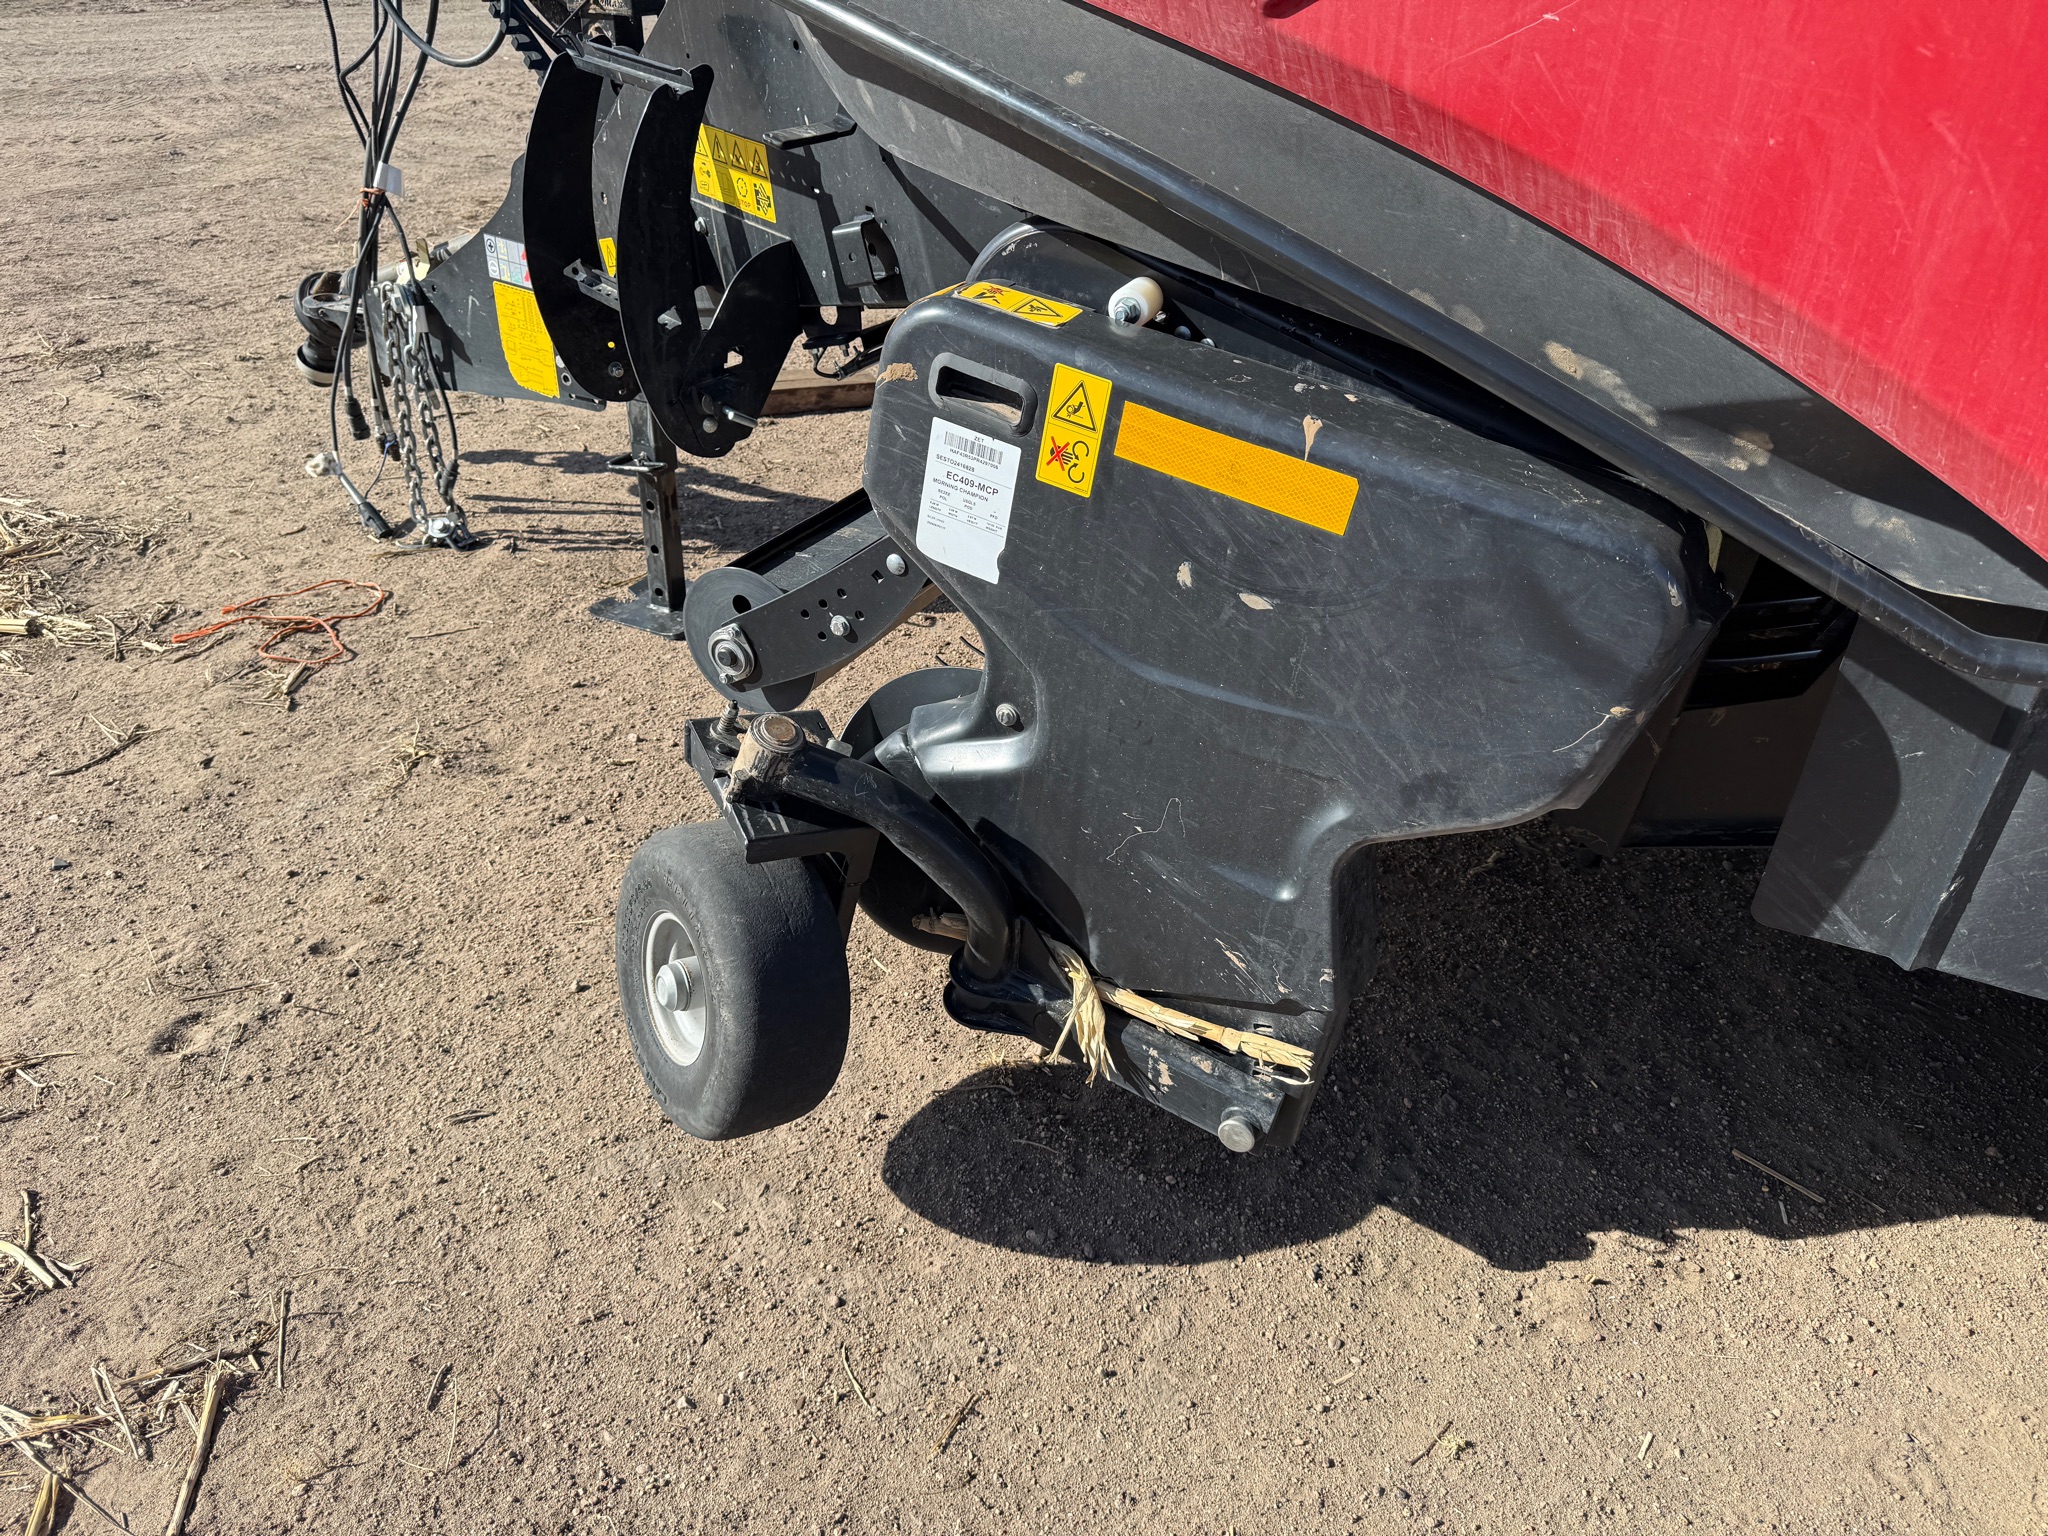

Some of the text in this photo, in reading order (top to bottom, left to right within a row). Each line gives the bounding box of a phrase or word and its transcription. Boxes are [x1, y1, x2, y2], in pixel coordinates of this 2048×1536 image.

[932, 477, 989, 502] MORNING CHAMPION
[946, 470, 999, 496] EC409-MCP
